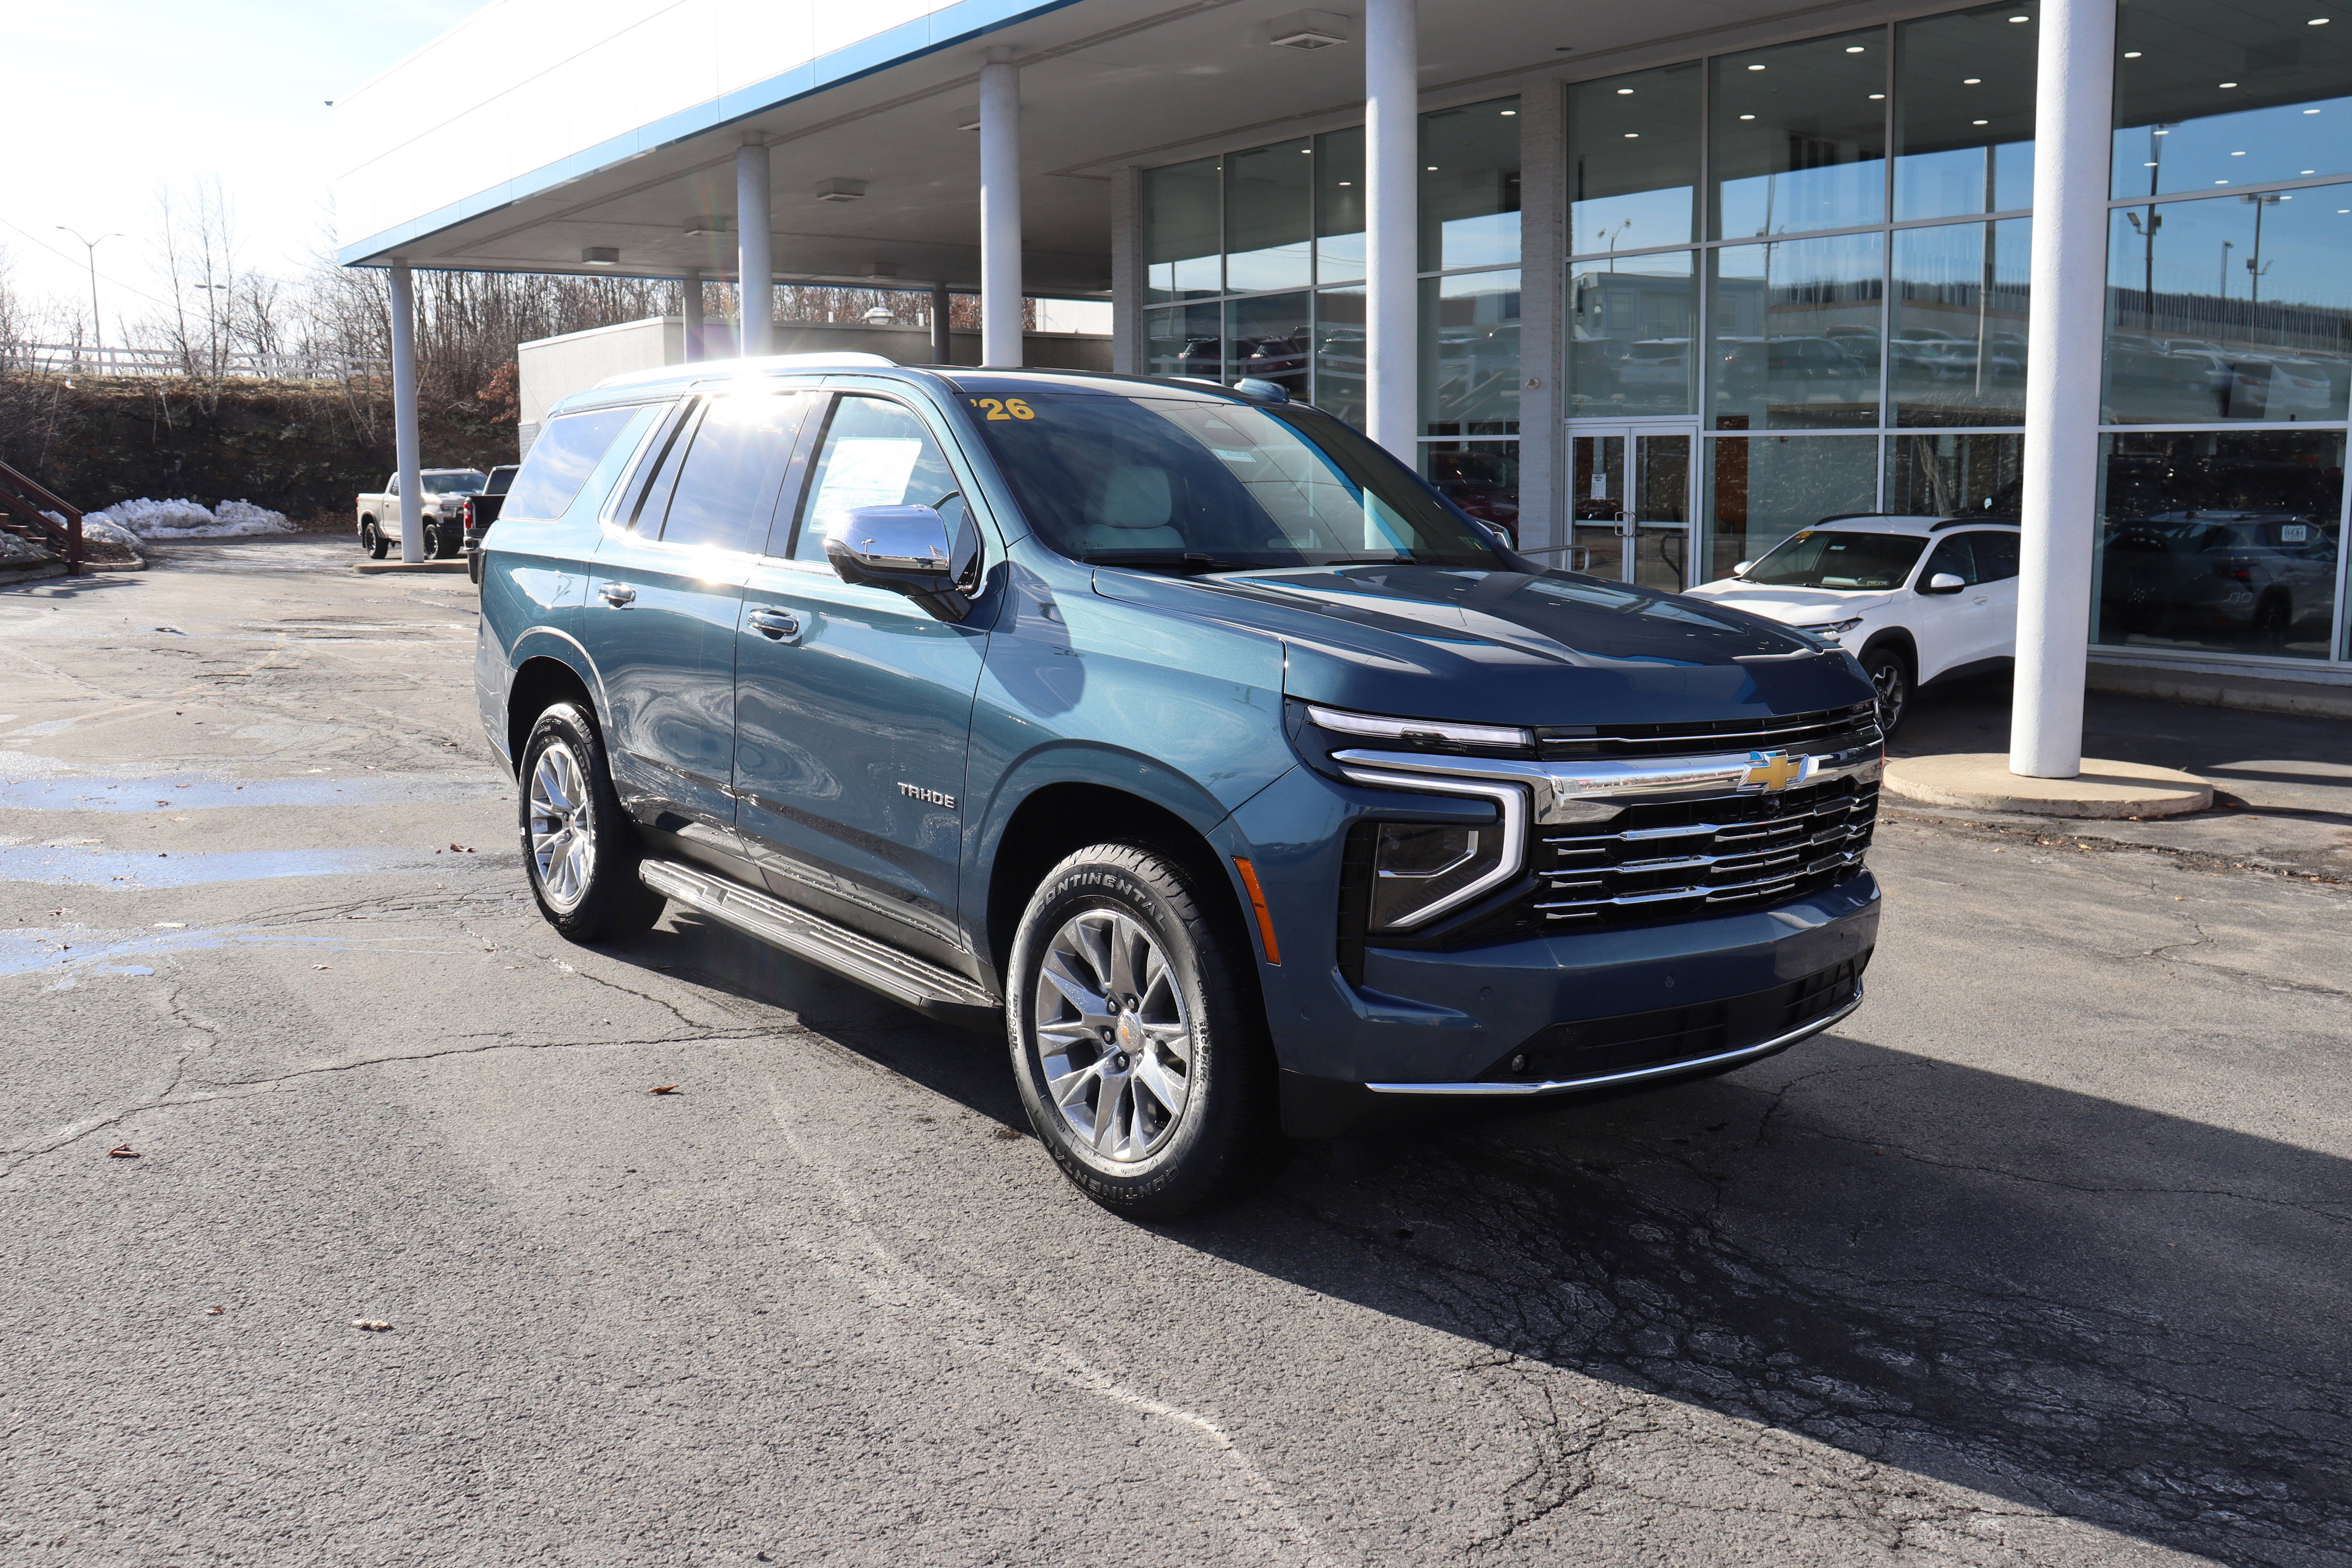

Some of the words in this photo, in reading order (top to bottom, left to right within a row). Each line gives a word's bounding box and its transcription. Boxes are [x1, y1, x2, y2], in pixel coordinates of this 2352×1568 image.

[969, 398, 1035, 421] '26
[897, 782, 956, 809] TAHOE
[1036, 872, 1167, 932] CONTINENTAL
